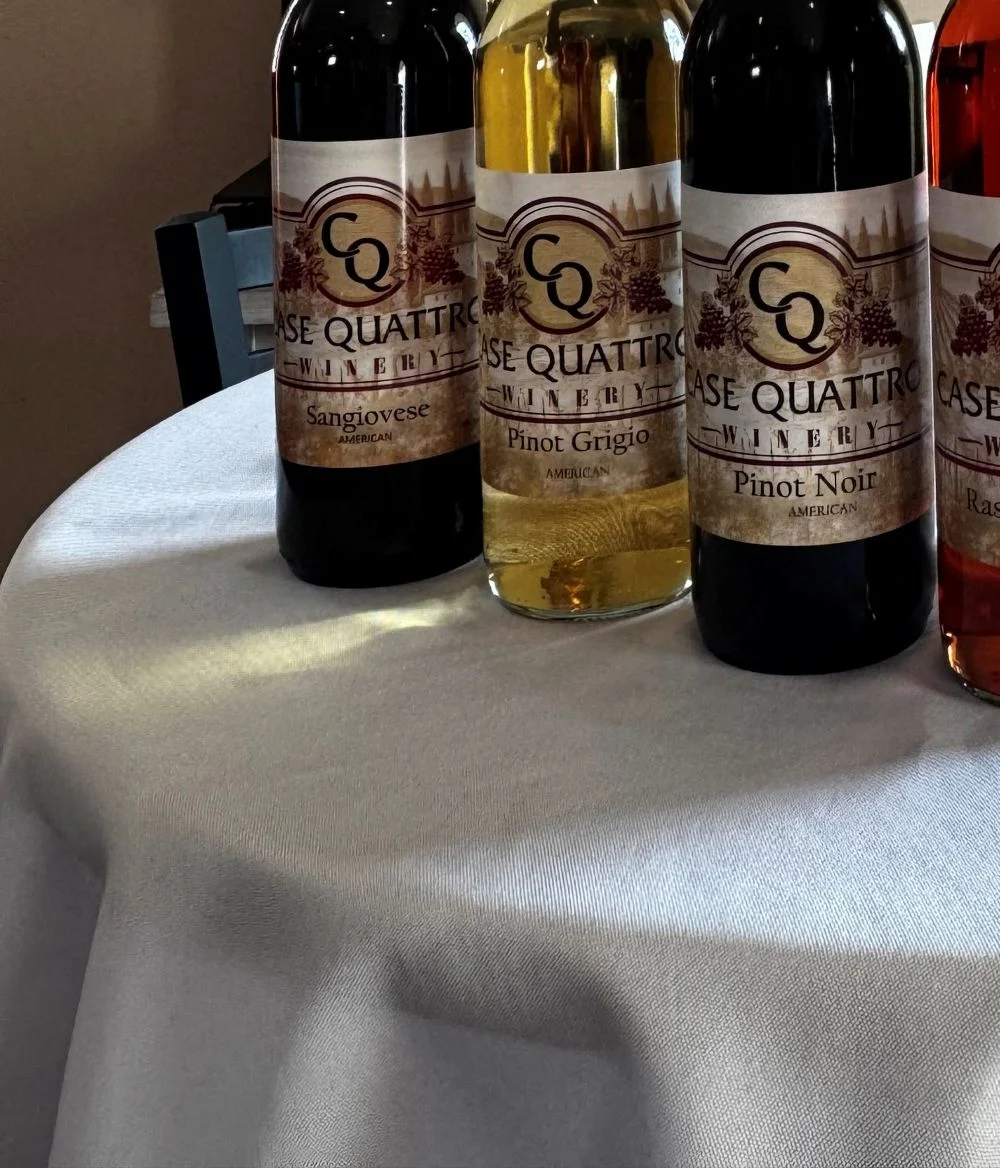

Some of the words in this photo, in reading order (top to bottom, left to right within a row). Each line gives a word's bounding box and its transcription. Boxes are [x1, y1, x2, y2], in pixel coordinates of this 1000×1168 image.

[275, 310, 314, 345] ASE
[299, 349, 441, 377] WINERY
[480, 333, 516, 371] ASE
[502, 381, 646, 407] WINERY
[751, 359, 921, 423] QUATTRO
[306, 403, 431, 433] Sangiovese
[338, 432, 393, 445] AMERICAN
[508, 427, 565, 452] Pinot
[571, 425, 650, 456] Grigio
[722, 419, 878, 449] WINERY
[546, 466, 610, 480] AMERICAN
[734, 470, 806, 498] Pinot
[815, 468, 877, 497] Noir
[788, 502, 858, 518] AMERICAN
